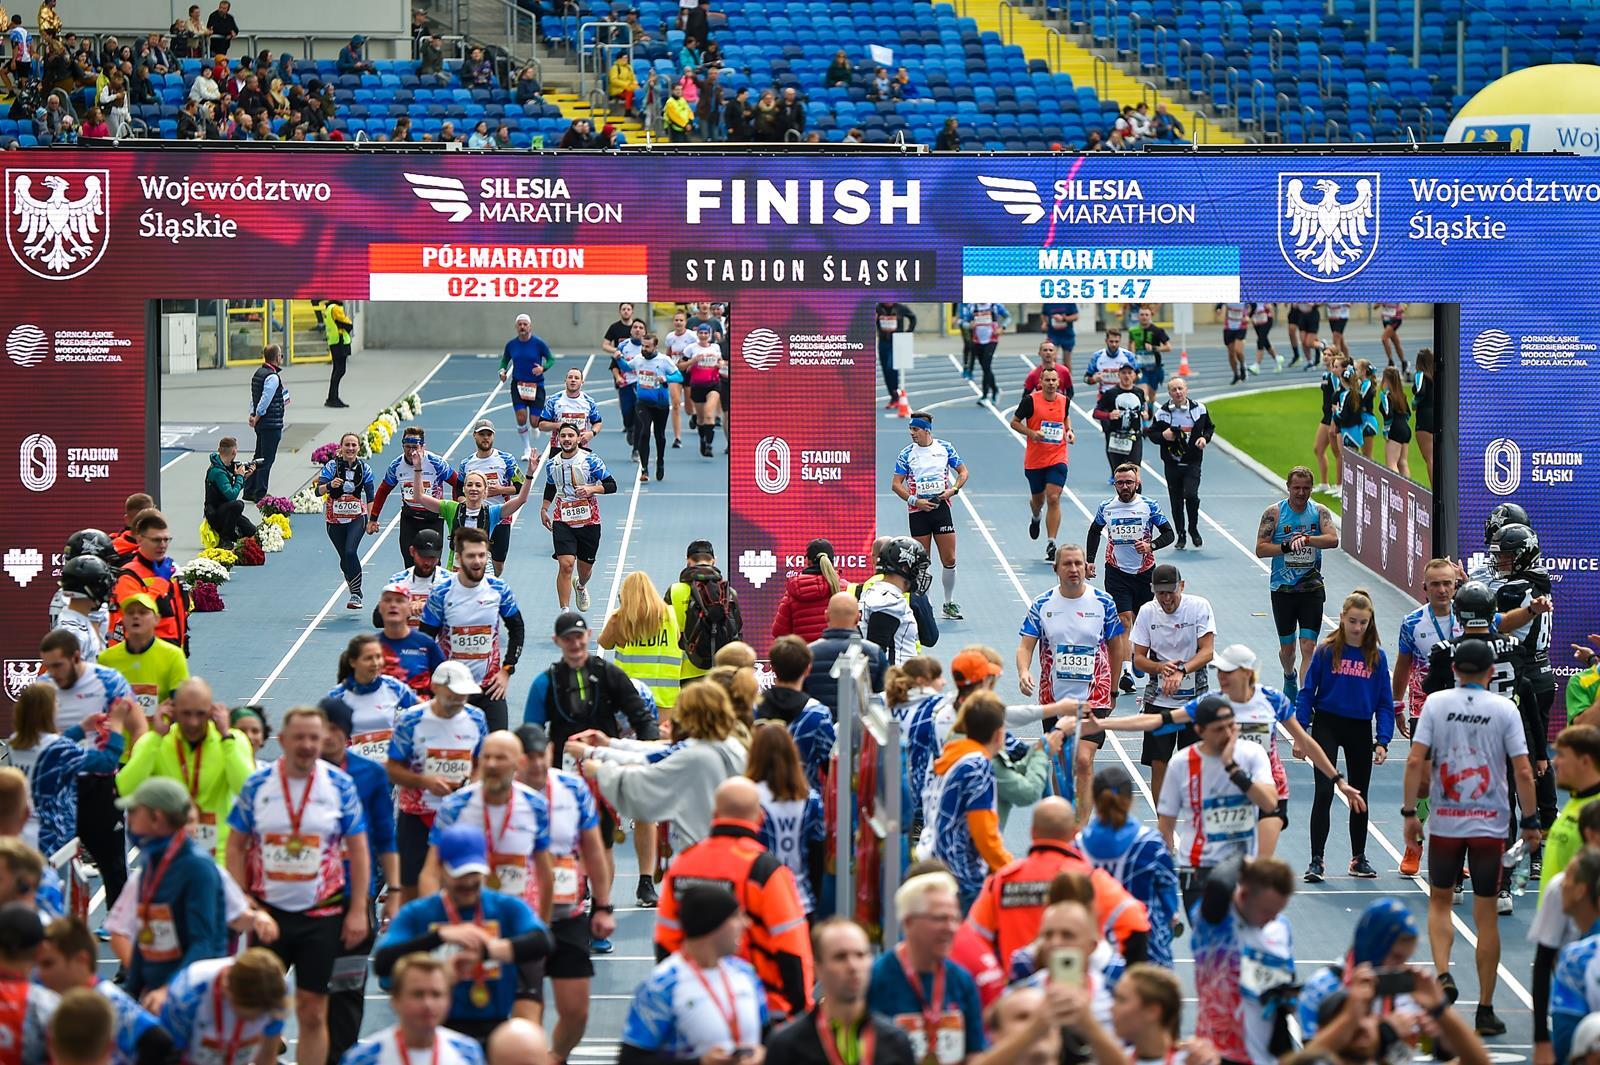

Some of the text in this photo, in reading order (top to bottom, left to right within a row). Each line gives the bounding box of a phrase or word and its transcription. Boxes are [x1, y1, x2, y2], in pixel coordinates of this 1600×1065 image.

[138, 175, 331, 206] Województwo
[479, 178, 570, 199] SILESIA
[1053, 179, 1144, 200] SILESIA
[1408, 178, 1600, 208] Województwo
[686, 178, 921, 225] FINISH
[479, 202, 622, 223] MARATHON
[1053, 203, 1195, 224] MARATHON
[139, 209, 238, 243] Śląskie
[1408, 210, 1507, 246] Śląskie
[422, 244, 585, 269] PÓŁMARATON
[1038, 249, 1154, 270] MARATON
[686, 255, 921, 286] STADION ŚLĄSKI
[447, 277, 560, 298] 02:10:22
[1039, 278, 1152, 299] 03:51:47
[67, 448, 119, 461] STADION
[801, 450, 851, 464] STADION
[1532, 453, 1583, 466] STADION
[67, 461, 110, 483] ŚLĄSKI
[801, 464, 842, 485] ŚLĄSKI
[1531, 466, 1574, 486] ŚLĄSKI
[921, 482, 940, 490] 1841
[566, 507, 586, 516] 8188
[1116, 526, 1137, 534] 1531
[786, 555, 867, 568] KAWICE
[1539, 557, 1599, 571] TOWICE
[458, 636, 486, 646] 8150
[1062, 656, 1088, 666] 1331
[1354, 660, 1364, 670] IS
[1331, 667, 1373, 679] JOURNEY
[435, 761, 465, 773] 7084
[1213, 808, 1247, 823] 1772
